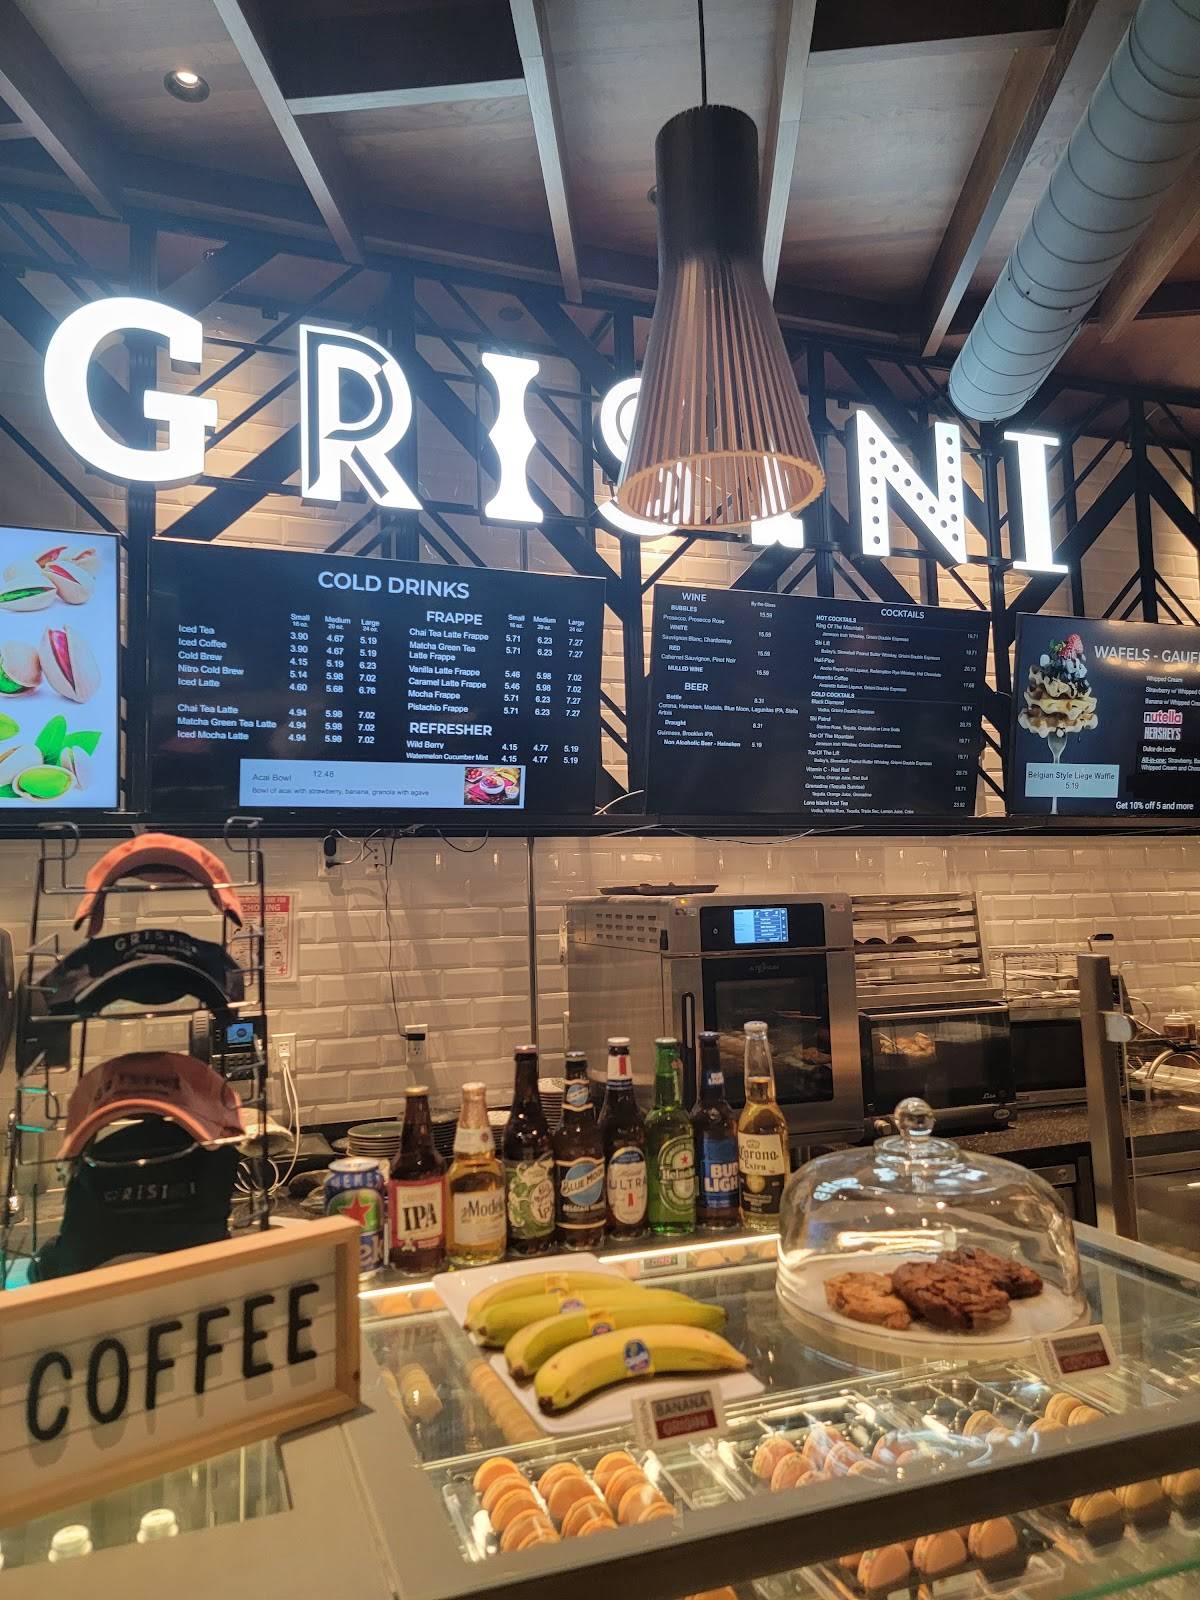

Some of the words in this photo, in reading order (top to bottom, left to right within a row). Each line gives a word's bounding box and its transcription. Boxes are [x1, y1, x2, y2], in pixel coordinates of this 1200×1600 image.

[44, 297, 1069, 573] GRINI
[318, 571, 382, 592] COLD
[388, 578, 470, 599] DRINKS
[682, 592, 707, 602] WINE
[427, 611, 482, 625] FRAPPE
[881, 608, 924, 619] COCKTAILS
[325, 616, 351, 624] Medium
[361, 619, 380, 628] Large
[179, 625, 197, 634] Iced
[199, 626, 214, 634] Tea
[409, 628, 426, 637] Chai
[464, 632, 488, 641] Frappe
[179, 638, 197, 647] Iced
[199, 639, 227, 648] Coffee
[410, 642, 437, 650] Matcha
[439, 643, 461, 651] Green
[290, 645, 308, 653] 3.90
[1094, 646, 1150, 661] WAFELS
[178, 651, 198, 660] Cold
[200, 652, 222, 661] Brew
[430, 653, 456, 662] Frappe
[290, 658, 308, 666] 4.15
[178, 664, 199, 673] Nitro
[200, 666, 220, 674] Cold
[222, 667, 244, 675] Brew
[409, 665, 433, 674] Vanilla
[454, 668, 480, 677] Frappe
[326, 672, 343, 680] 5.98
[178, 678, 196, 686] Iced
[198, 678, 220, 688] Latte
[289, 683, 307, 691] 4.60
[326, 685, 343, 693] 5.68
[408, 678, 440, 686] Caramel
[461, 681, 486, 689] Frappe
[685, 683, 708, 691] BEER
[408, 690, 433, 698] Mocha
[435, 692, 460, 700] Frappe
[178, 704, 198, 713] Chai
[200, 705, 215, 714] Tea
[217, 705, 238, 714] Latte
[408, 703, 441, 712] Pistachio
[443, 705, 468, 713] Frappe
[325, 710, 342, 718] 5.98
[1144, 709, 1182, 724] nutella
[178, 717, 209, 726] Matcha
[211, 718, 237, 727] Green
[239, 720, 254, 728] Tea
[256, 720, 277, 728] Latte
[288, 721, 306, 729] 4.94
[410, 722, 492, 736] REFRESHER
[1144, 727, 1181, 740] HERSHEY'S
[178, 731, 196, 739] Iced
[198, 731, 226, 740] Mocha
[228, 732, 249, 740] Latte
[325, 735, 342, 743] 5.98
[406, 740, 423, 748] Wild
[425, 741, 444, 749] Berry
[252, 774, 269, 782] Acai
[272, 774, 291, 782] Bowl
[1028, 771, 1054, 780] Belgian
[1056, 772, 1073, 780] Style
[1075, 772, 1093, 780] Liege
[1116, 801, 1128, 810] Get
[1130, 802, 1143, 810] 10%
[241, 904, 281, 912] CHOING
[704, 1176, 738, 1192] LIGH
[402, 1203, 437, 1231] IPA
[26, 1282, 320, 1441] COFFEE
[656, 1395, 708, 1417] BANANA
